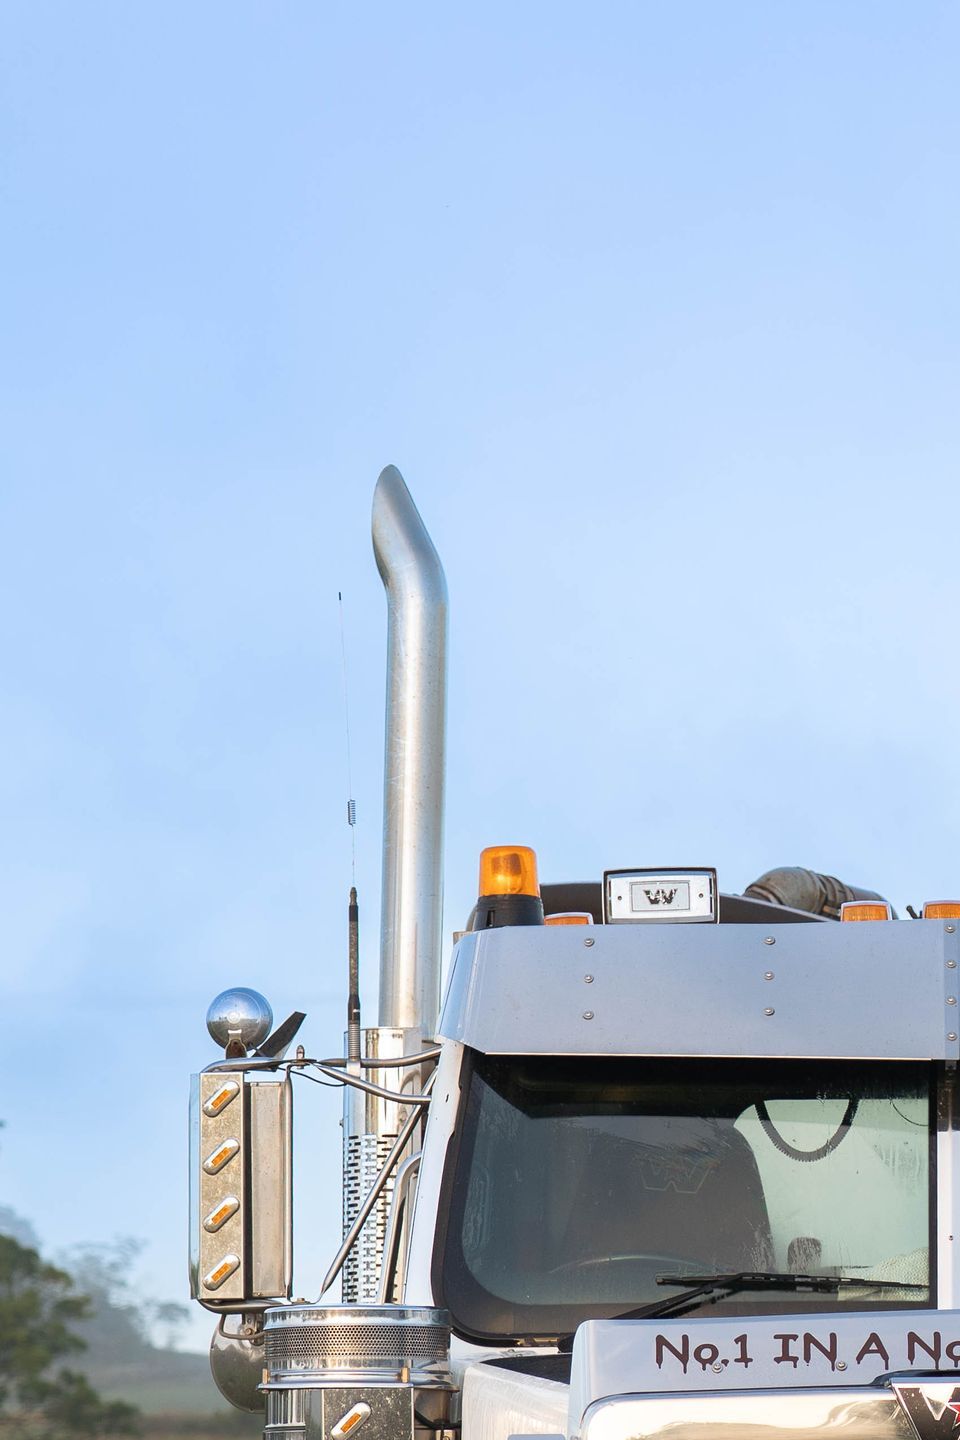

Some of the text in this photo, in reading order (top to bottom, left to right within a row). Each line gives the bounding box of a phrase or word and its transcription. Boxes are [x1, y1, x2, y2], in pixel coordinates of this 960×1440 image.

[655, 1333, 753, 1374] No.1
[773, 1332, 838, 1372] IN
[856, 1332, 890, 1371] A
